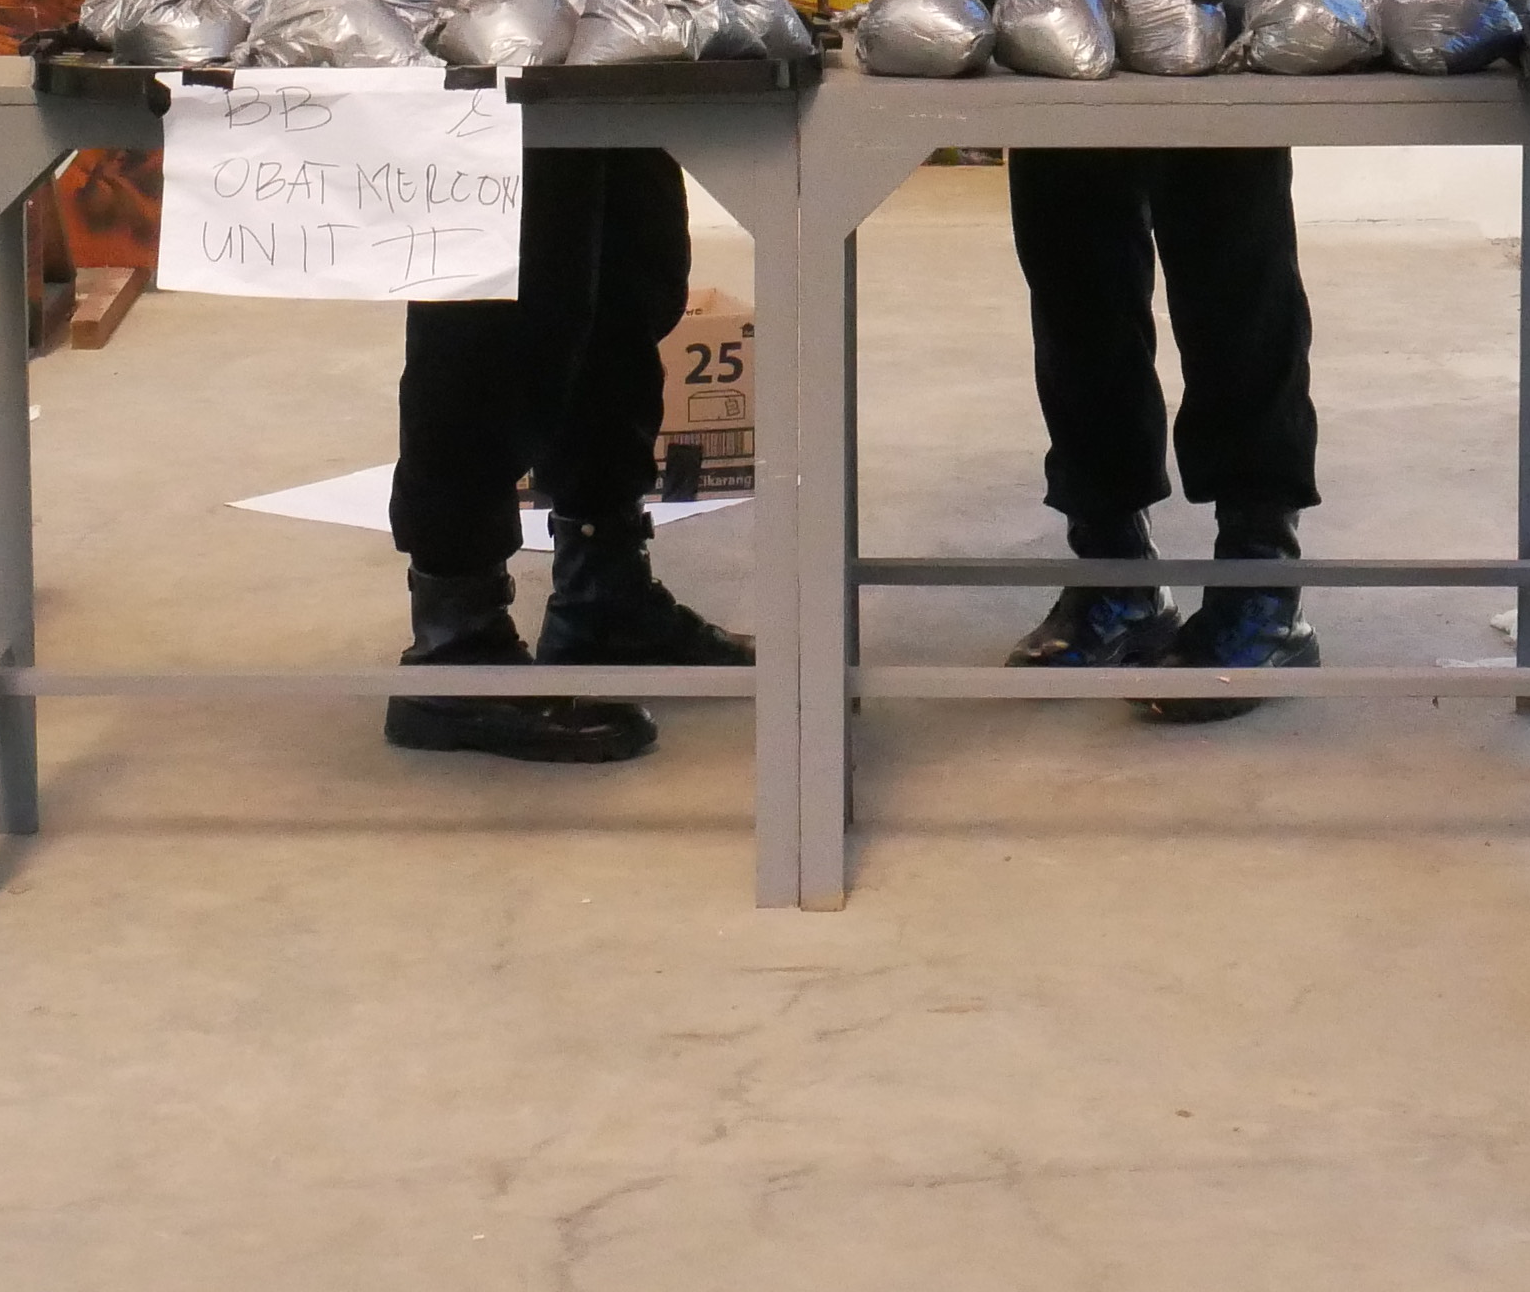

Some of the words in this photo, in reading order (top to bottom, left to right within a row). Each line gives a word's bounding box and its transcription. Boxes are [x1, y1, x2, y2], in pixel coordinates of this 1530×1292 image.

[225, 86, 332, 132] BB
[213, 157, 340, 205] OBAT
[356, 163, 519, 214] MERCON
[203, 221, 360, 273] UNIT
[685, 342, 744, 385] 25
